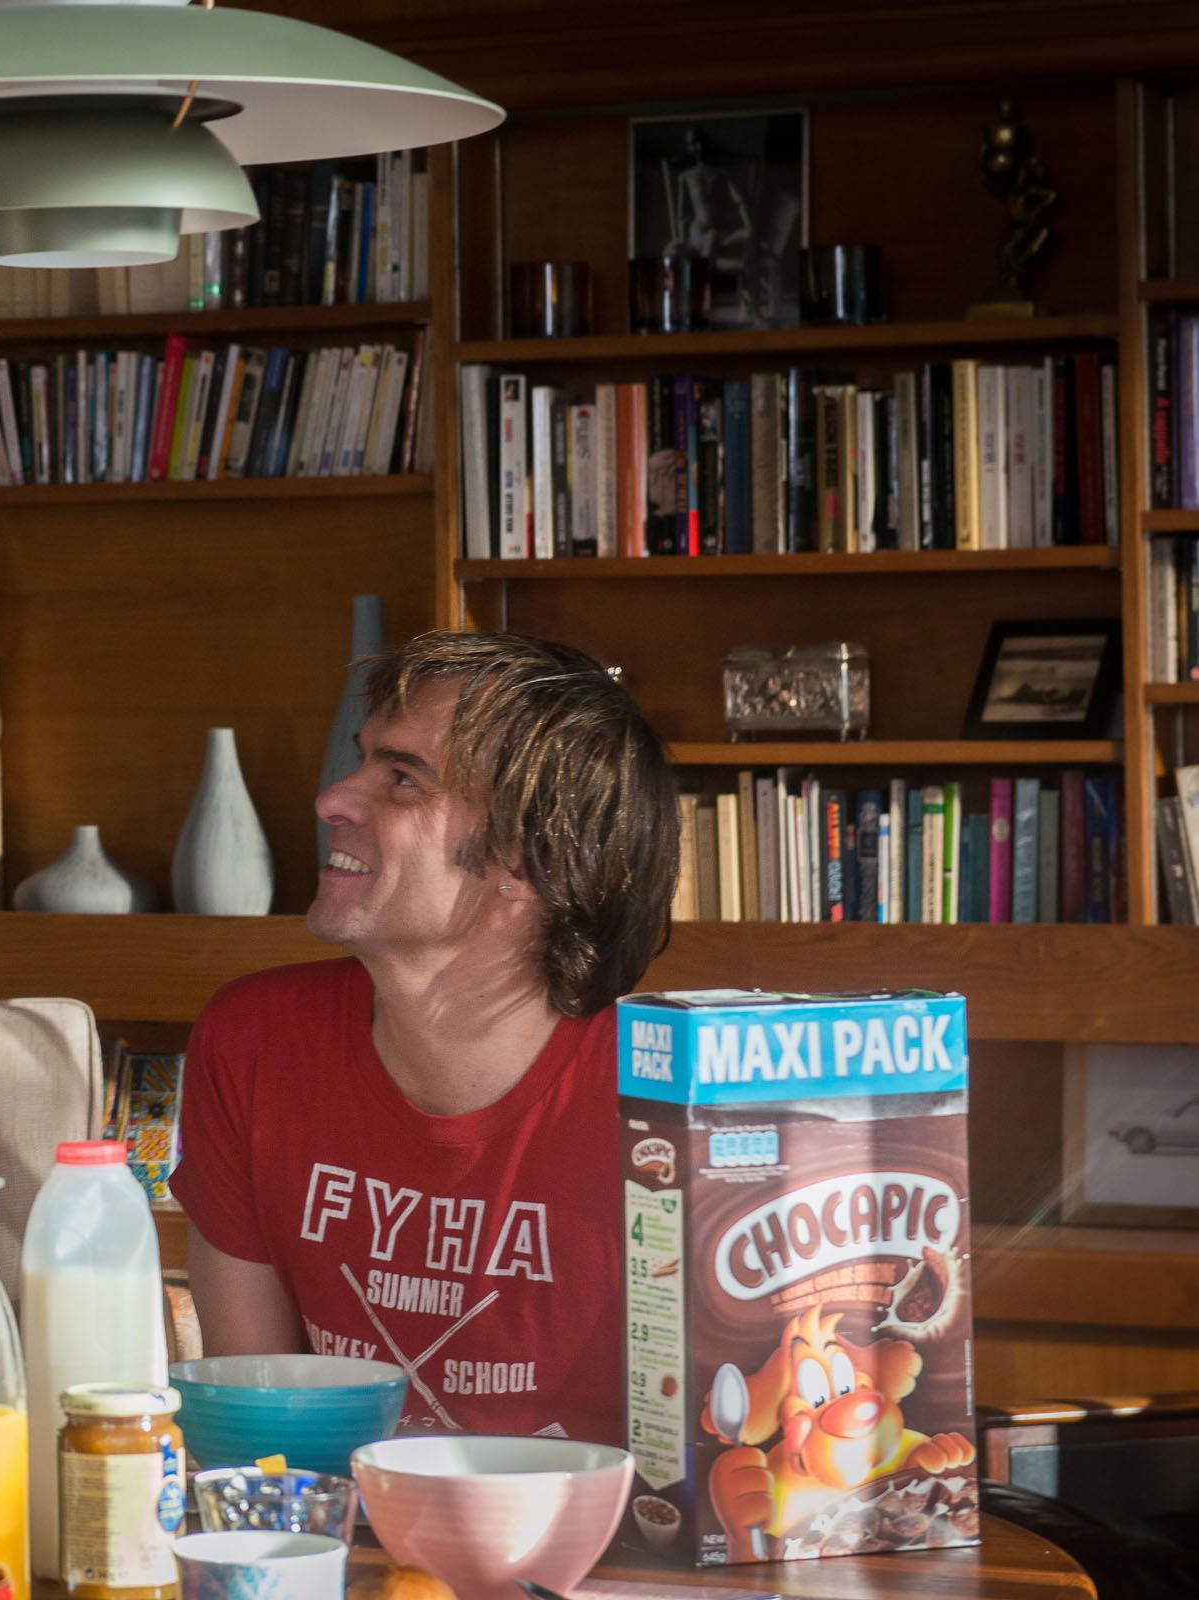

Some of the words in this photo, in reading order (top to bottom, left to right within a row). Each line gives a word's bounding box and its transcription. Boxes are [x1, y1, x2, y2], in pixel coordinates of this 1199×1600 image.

[631, 1020, 672, 1050] MAXI
[698, 1020, 822, 1085] MAXI
[833, 1014, 953, 1077] PACK
[632, 1051, 673, 1082] PACK
[300, 1162, 554, 1282] FYHA
[631, 1211, 644, 1247] 4
[728, 1183, 949, 1288] CHOCAPIC
[366, 1269, 465, 1318] SUMMER
[303, 1314, 378, 1361] OCKEY
[442, 1359, 538, 1395] SCHOOL
